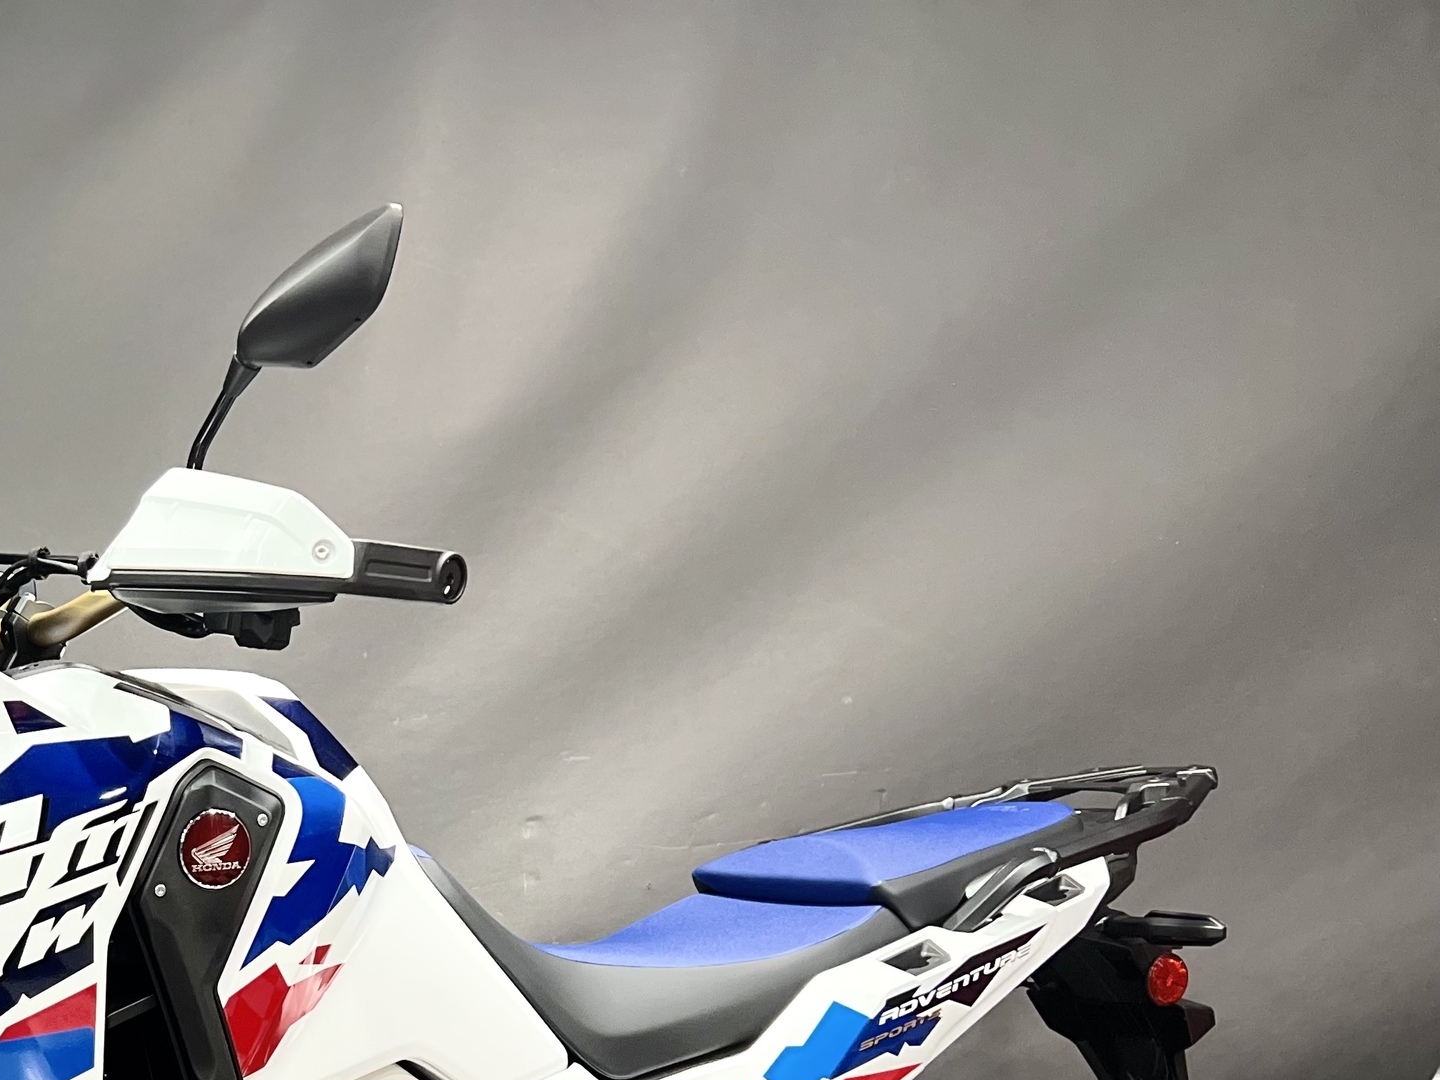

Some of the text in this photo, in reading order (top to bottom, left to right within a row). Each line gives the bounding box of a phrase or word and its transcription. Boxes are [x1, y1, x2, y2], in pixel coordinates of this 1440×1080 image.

[191, 860, 242, 873] HONDA
[877, 943, 1033, 1026] ADVENTURE
[859, 1006, 944, 1053] SPORTS
